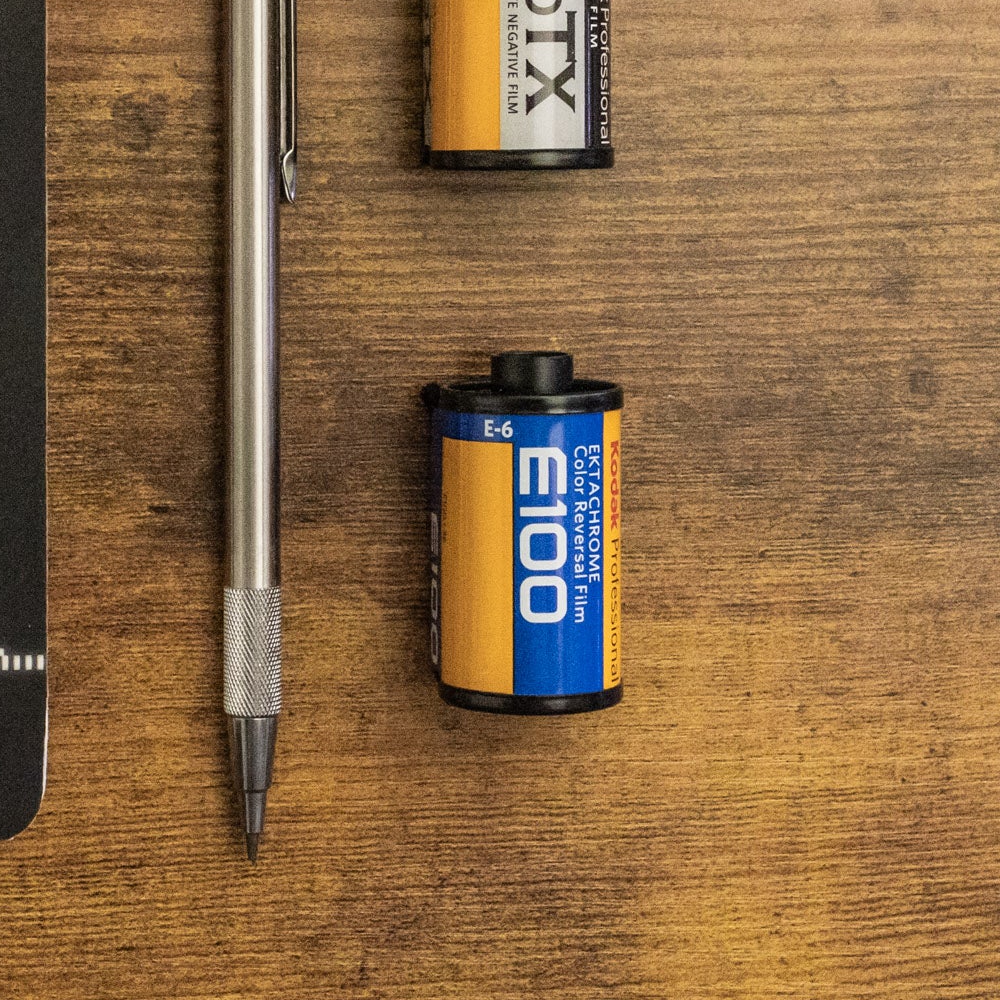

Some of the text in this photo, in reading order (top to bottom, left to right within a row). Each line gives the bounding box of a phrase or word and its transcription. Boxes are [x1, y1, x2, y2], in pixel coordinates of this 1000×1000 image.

[507, 14, 518, 78] NEGATIVE
[589, 6, 598, 48] FILM
[600, 8, 610, 145] Professional
[507, 84, 518, 115] FILM
[484, 419, 514, 438] E-6
[519, 447, 568, 624] E100
[574, 445, 588, 624] Color Reversal Film
[588, 444, 601, 583] EKTACHROME
[610, 440, 620, 683] Kodak Professional
